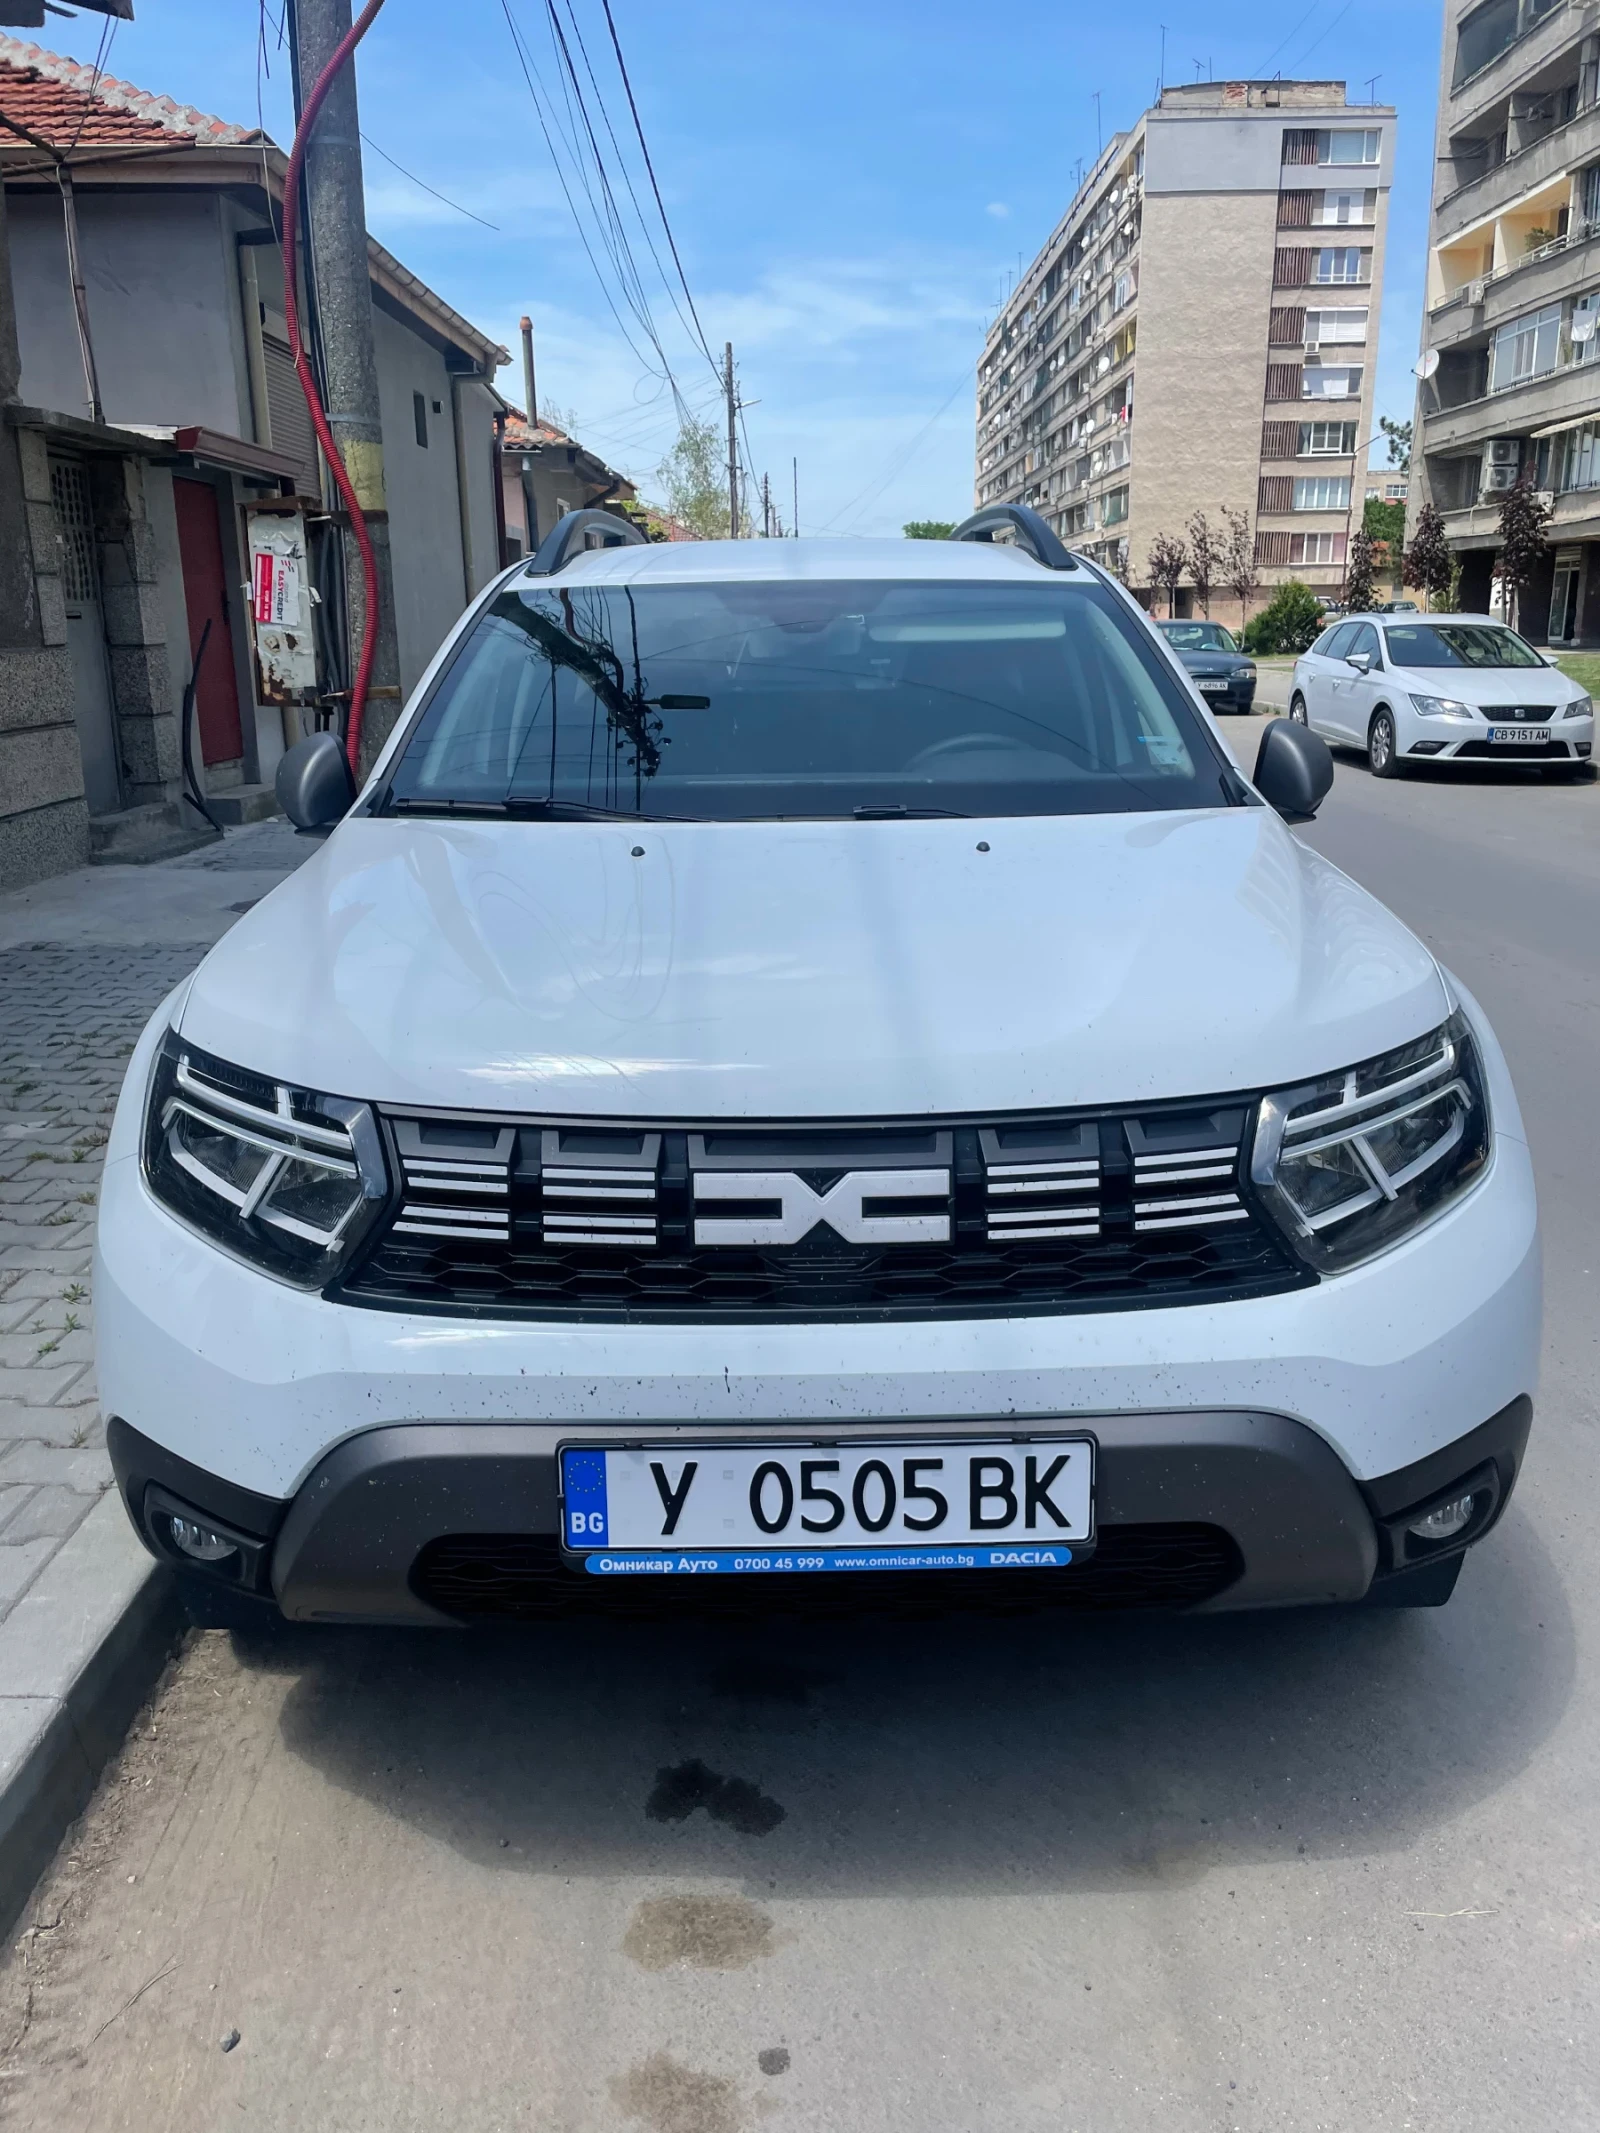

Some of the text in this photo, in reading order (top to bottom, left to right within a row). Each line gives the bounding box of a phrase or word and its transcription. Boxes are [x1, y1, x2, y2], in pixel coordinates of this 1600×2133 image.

[1495, 730, 1508, 740] CB
[1510, 730, 1533, 740] 9151
[1535, 731, 1549, 740] AM
[749, 1457, 949, 1534] 0505
[970, 1455, 1072, 1530] BK
[571, 1512, 604, 1533] BG
[599, 1552, 1056, 1573] Омникар Ауто 0700 45 999 www.omnicar-auto.bg DACIA
